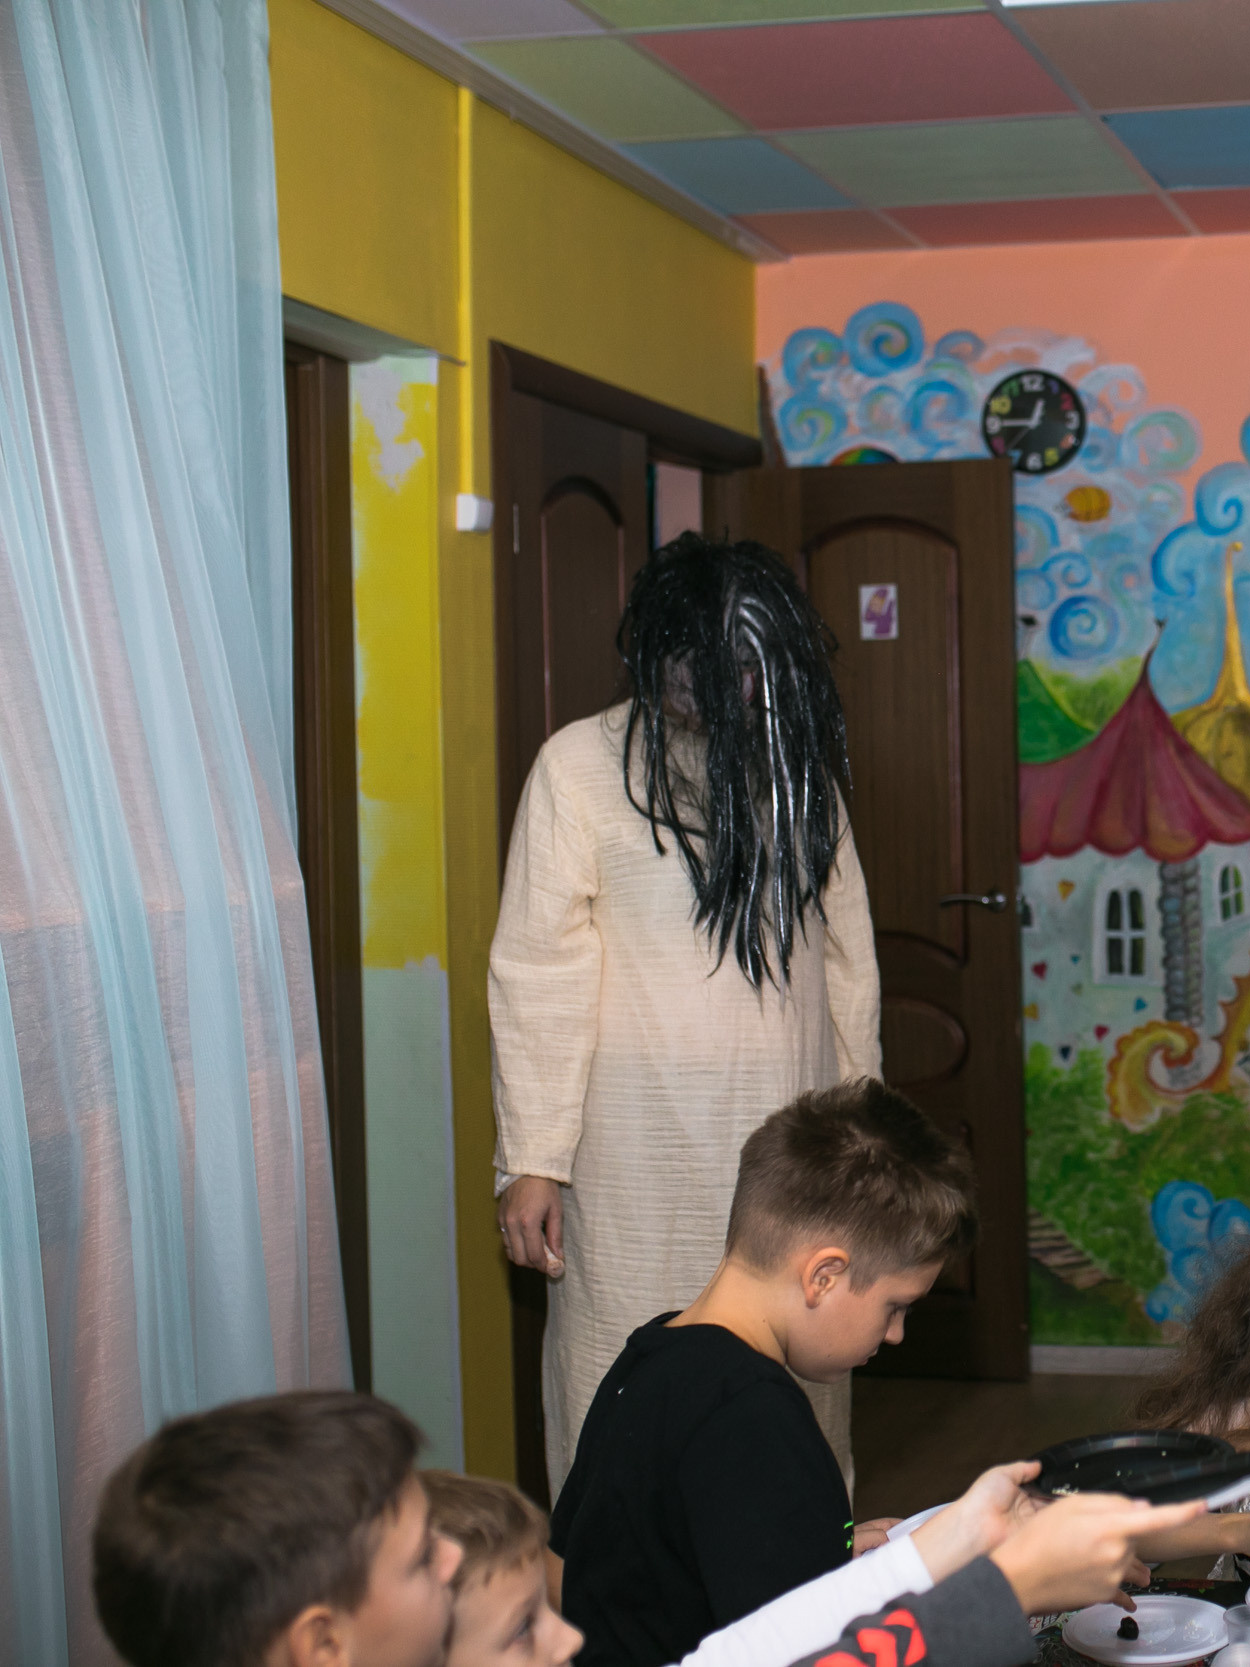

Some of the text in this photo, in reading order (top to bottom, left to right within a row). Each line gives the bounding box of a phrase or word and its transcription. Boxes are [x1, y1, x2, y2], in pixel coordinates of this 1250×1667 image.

[1022, 374, 1045, 392] 12
[1065, 410, 1080, 430] 3
[1026, 453, 1042, 470] 6
[865, 587, 895, 636] 4
